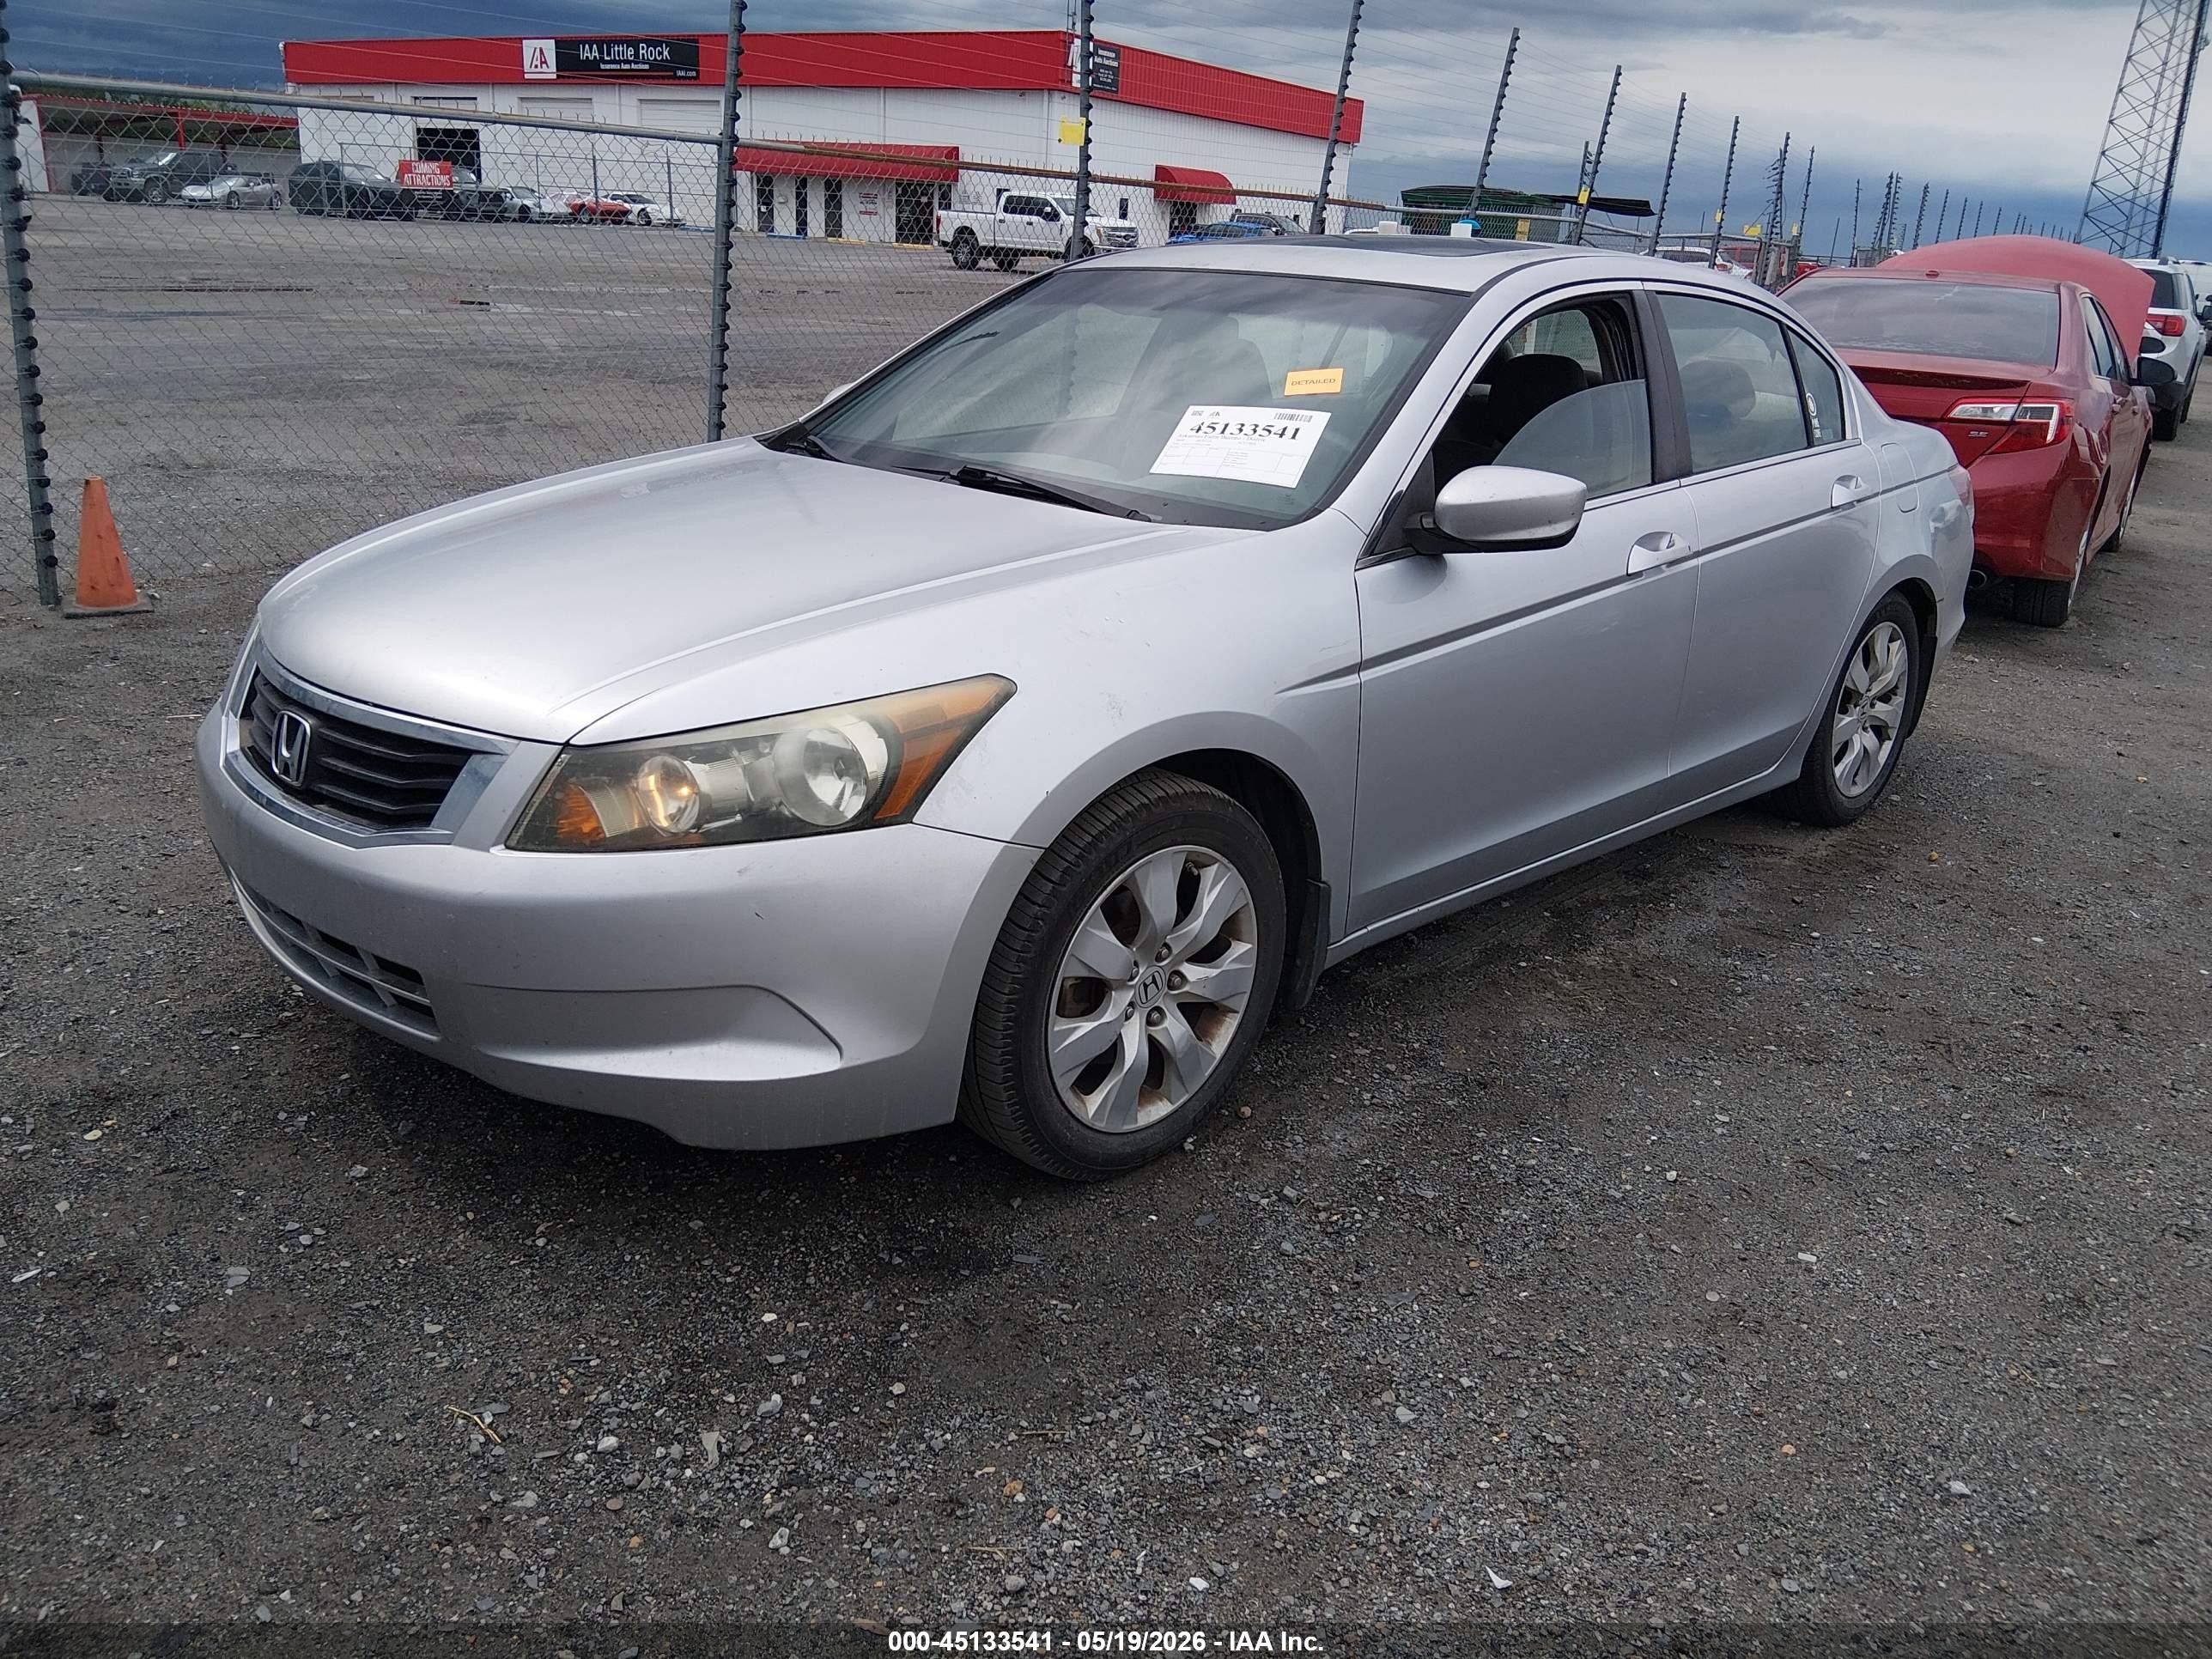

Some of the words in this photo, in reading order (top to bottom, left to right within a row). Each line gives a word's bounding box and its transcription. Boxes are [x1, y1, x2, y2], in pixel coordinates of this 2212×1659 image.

[579, 43, 599, 60] IAA
[604, 43, 635, 60] Little
[639, 43, 671, 60] Rock
[412, 161, 441, 173] COMING
[404, 173, 451, 186] ATTRACTIONS
[1291, 378, 1336, 386] DETAILED
[1189, 422, 1301, 441] 45133541
